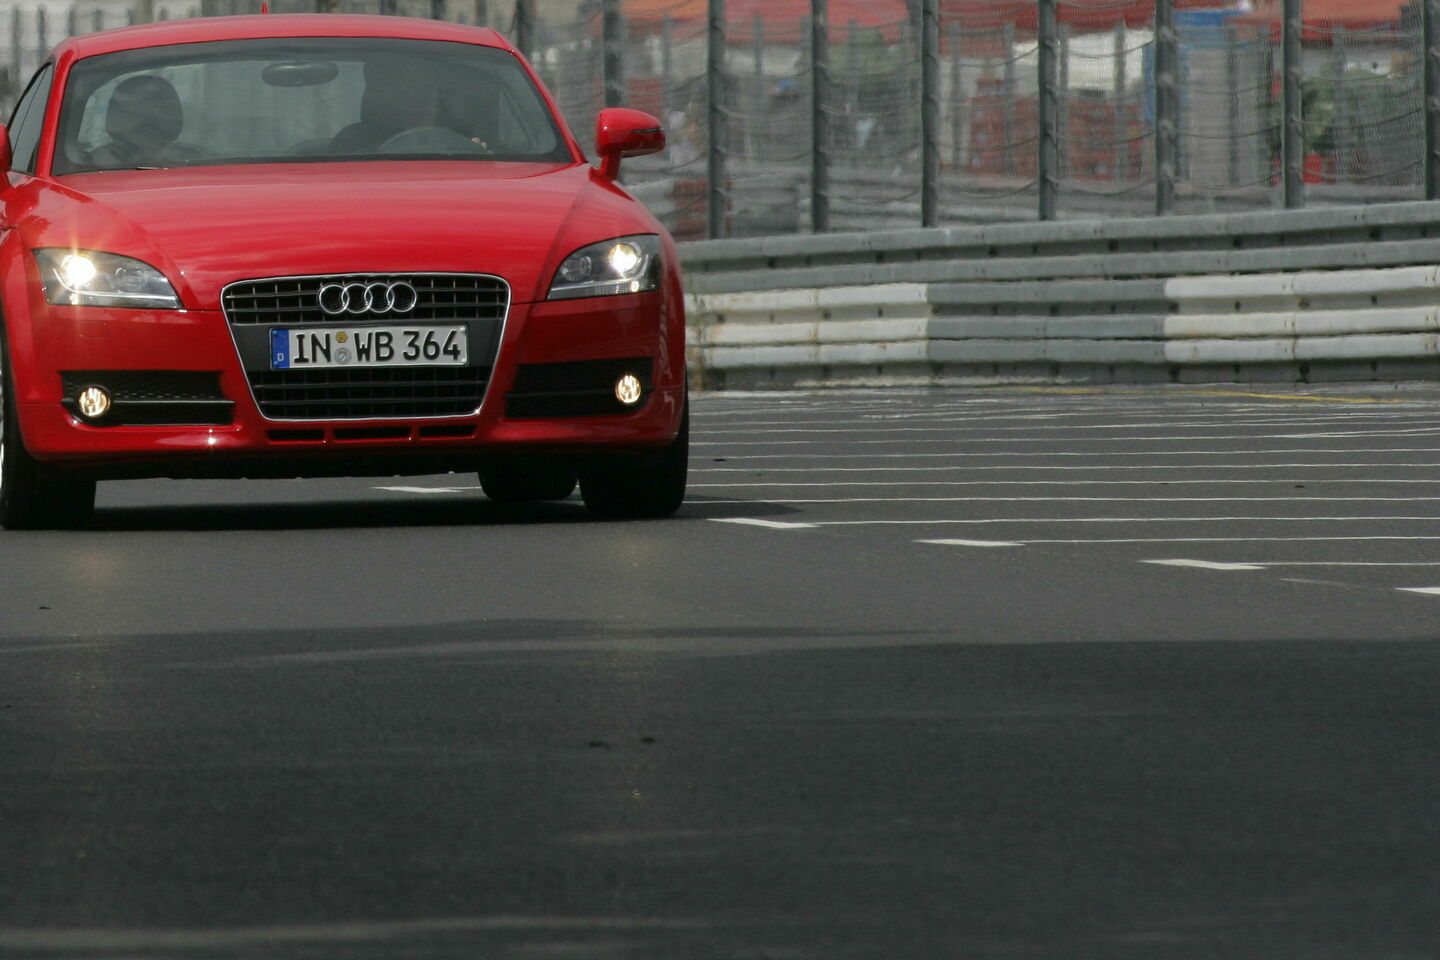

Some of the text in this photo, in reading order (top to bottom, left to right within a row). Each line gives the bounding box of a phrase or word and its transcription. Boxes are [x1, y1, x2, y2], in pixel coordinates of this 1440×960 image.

[294, 330, 460, 363] IN WB 364
[277, 353, 284, 362] D
